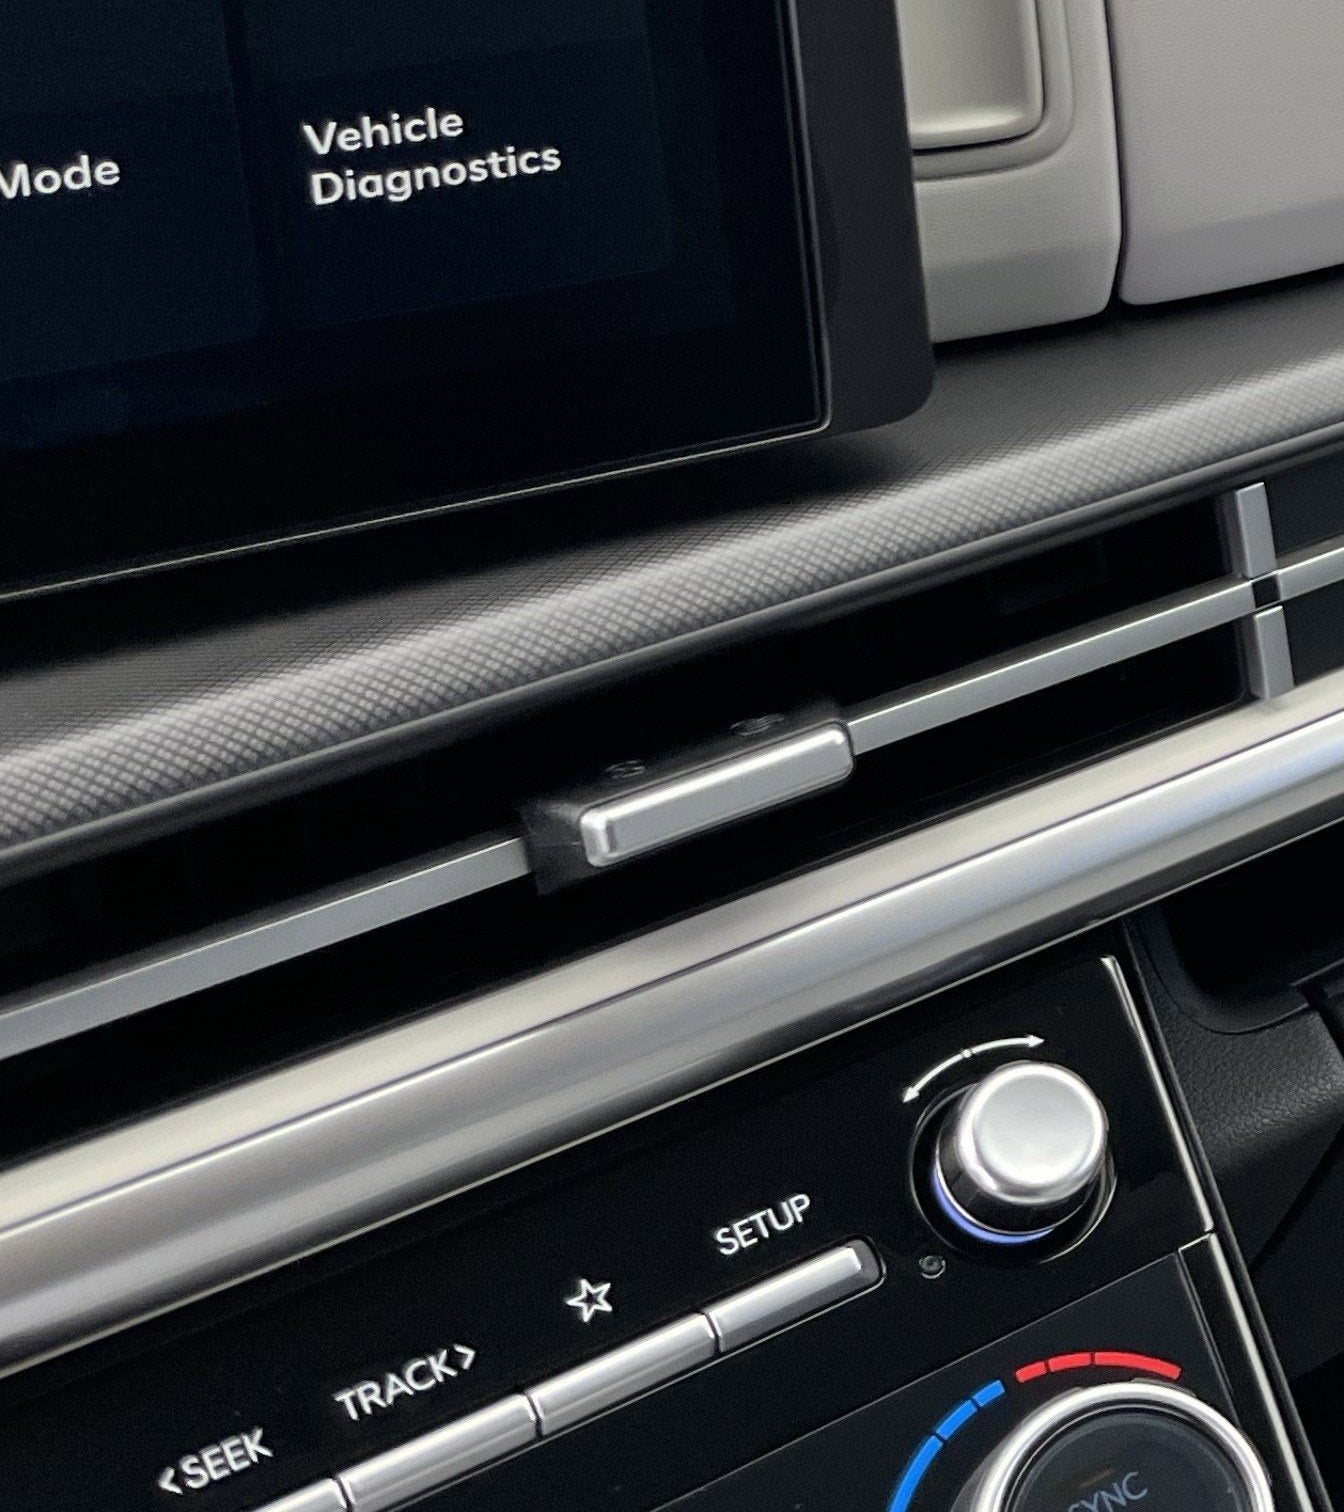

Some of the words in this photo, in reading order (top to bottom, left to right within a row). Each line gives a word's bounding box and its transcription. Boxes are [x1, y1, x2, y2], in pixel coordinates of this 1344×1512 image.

[303, 107, 464, 156] Vehicle
[0, 155, 120, 199] Mode
[311, 146, 562, 205] Diagnostics
[714, 1193, 811, 1256] SETUP
